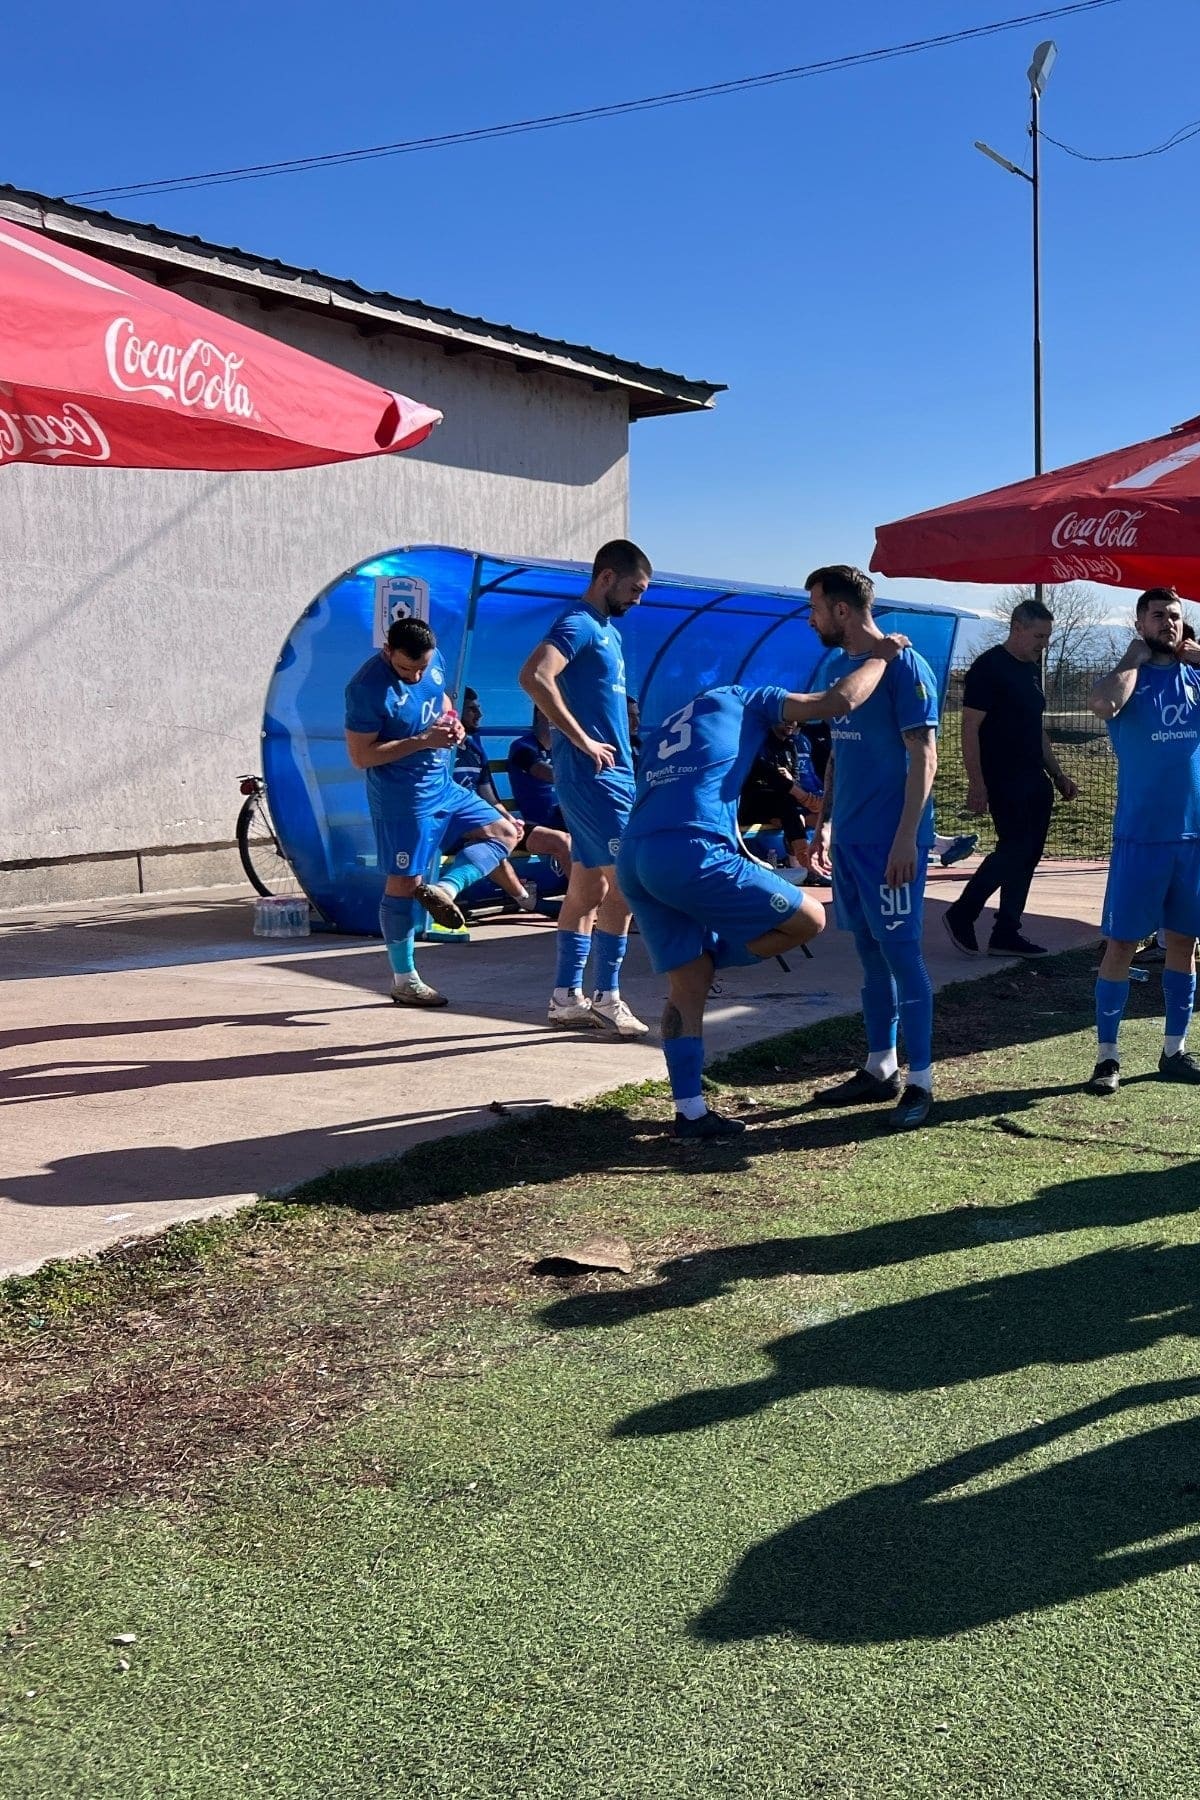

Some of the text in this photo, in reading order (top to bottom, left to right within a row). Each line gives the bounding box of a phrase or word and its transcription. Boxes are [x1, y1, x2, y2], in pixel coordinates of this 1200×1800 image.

[105, 317, 254, 418] Coca-Cola
[1051, 509, 1148, 549] Coca-Cola
[658, 701, 695, 760] 3
[1151, 730, 1197, 742] alphawin
